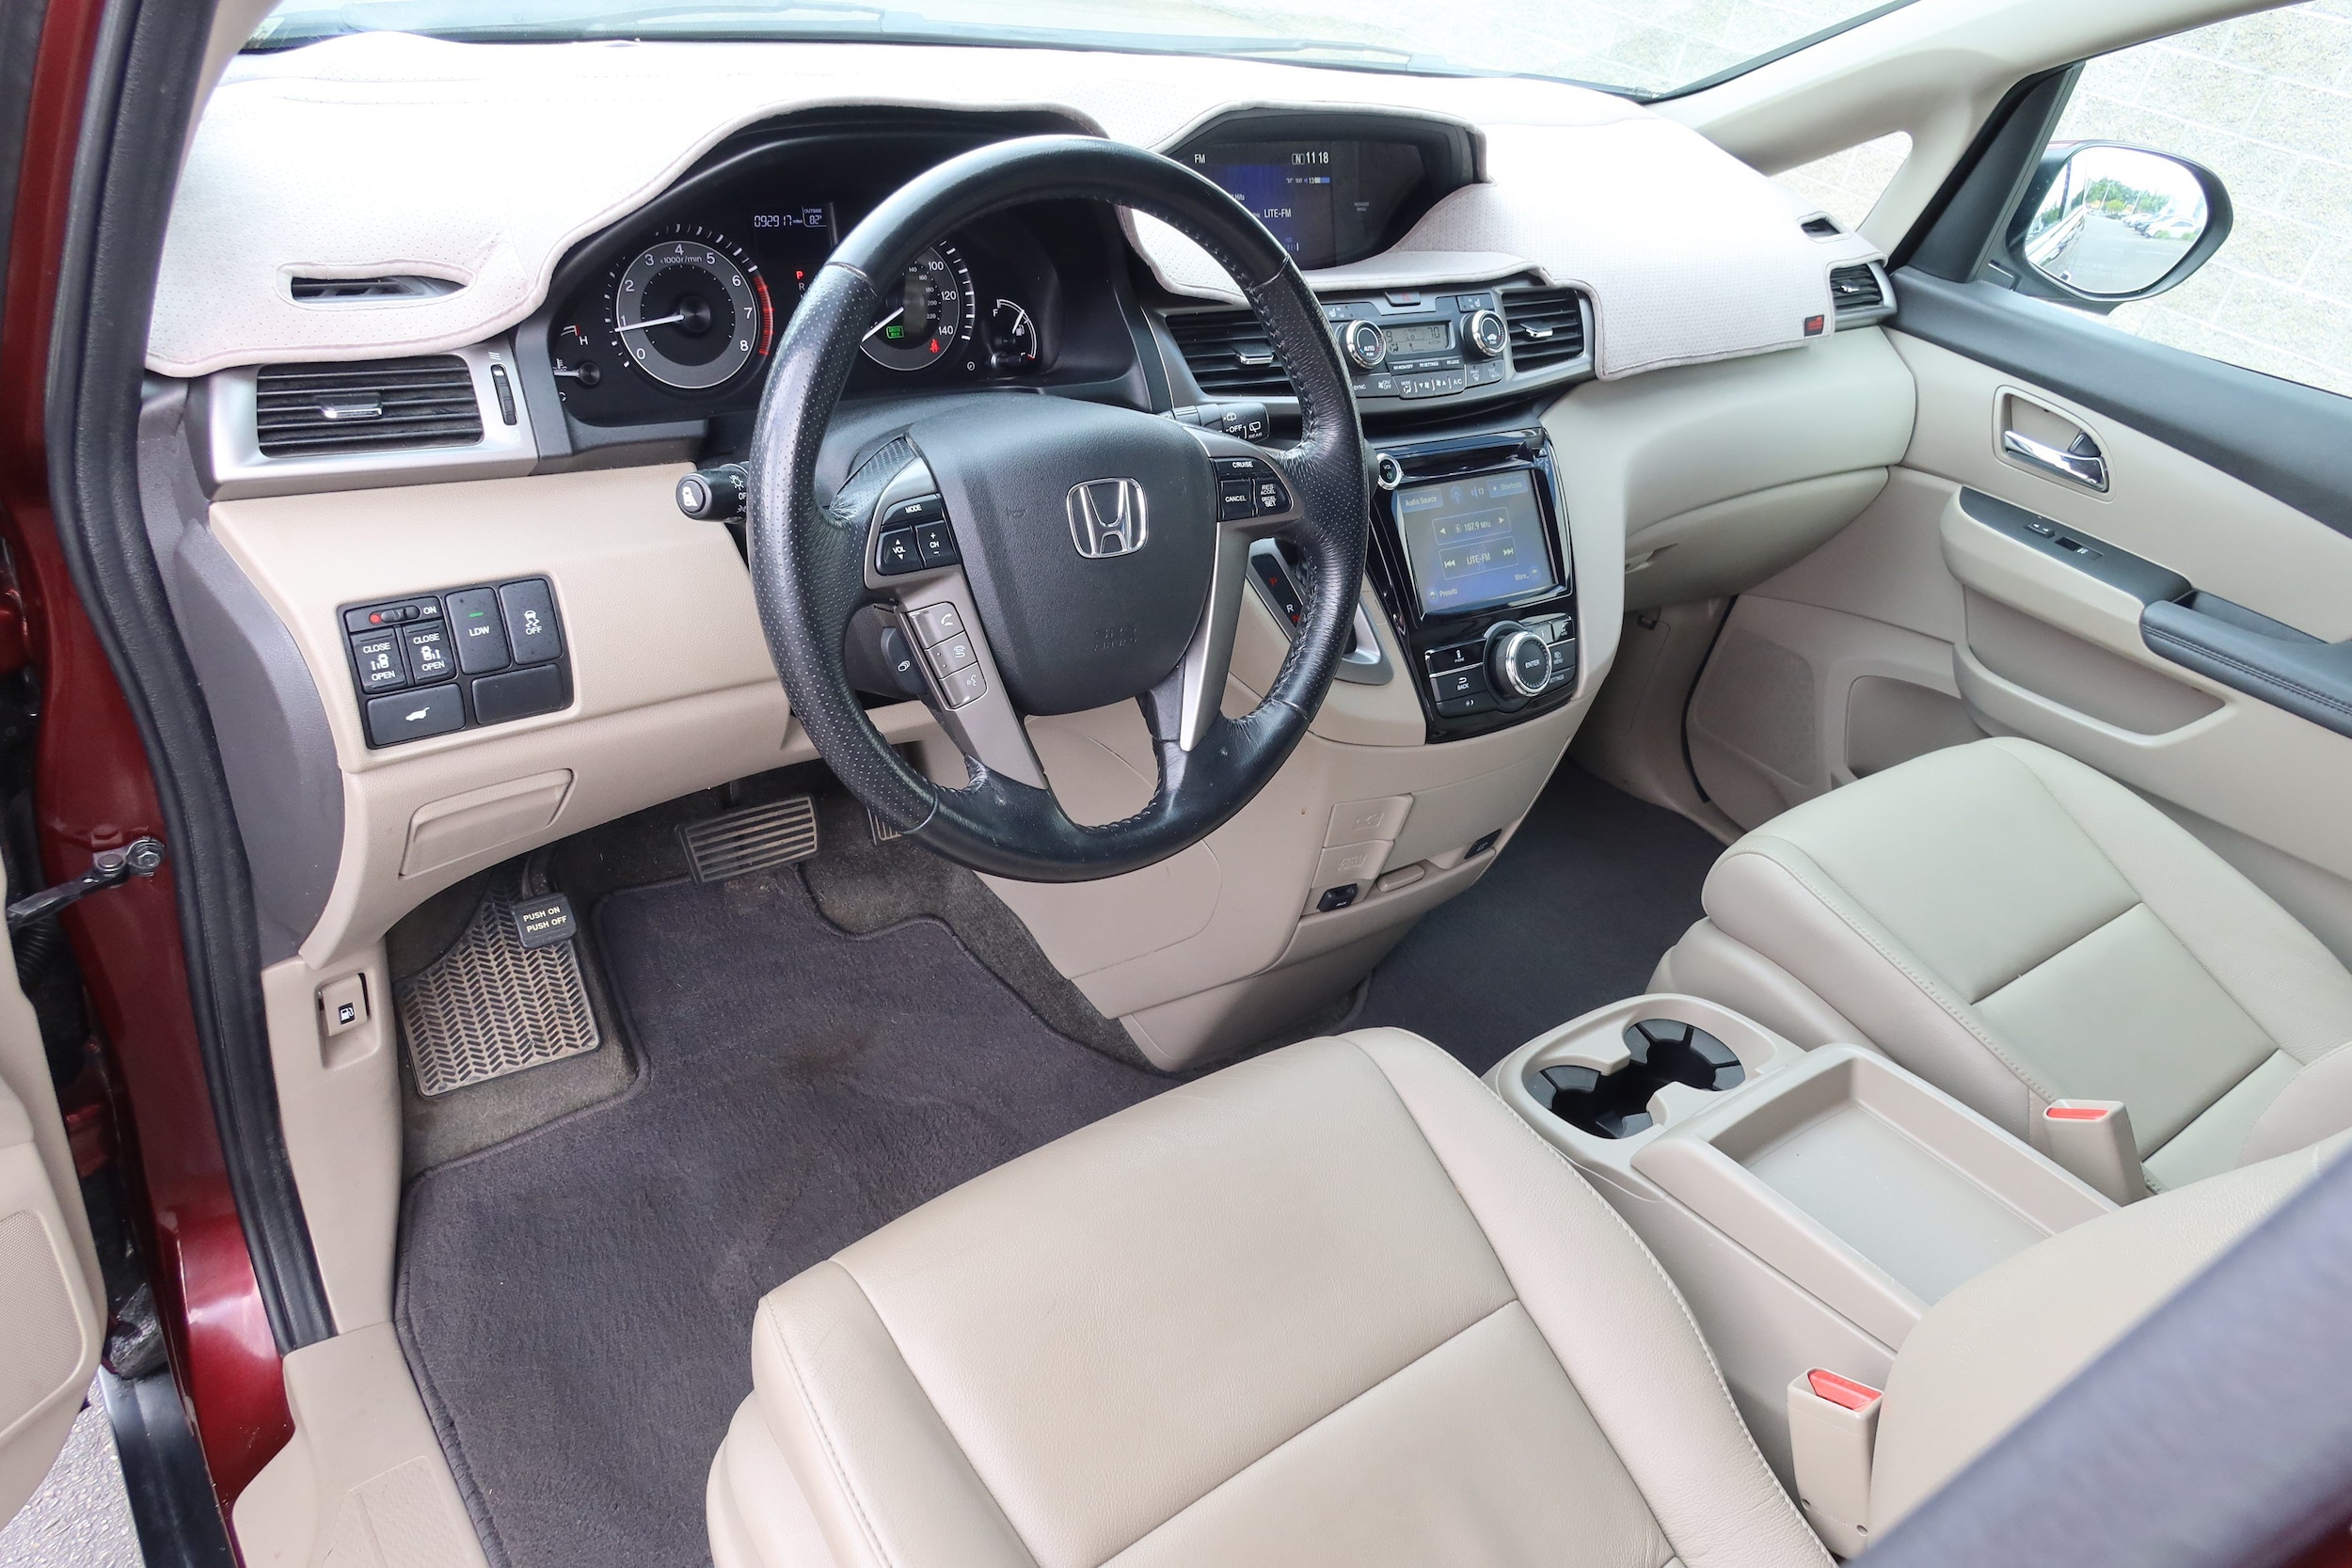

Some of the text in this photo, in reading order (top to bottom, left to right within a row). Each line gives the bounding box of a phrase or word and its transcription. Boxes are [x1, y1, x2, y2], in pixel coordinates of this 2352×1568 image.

[1194, 153, 1206, 164] FM
[1263, 208, 1292, 218] LITE-FM
[754, 214, 792, 228] 092917
[675, 244, 684, 255] 4
[644, 255, 655, 266] 3
[706, 253, 716, 264] 5
[928, 261, 945, 271] 100
[796, 270, 803, 280] P
[625, 280, 635, 292] 2
[732, 275, 741, 287] 6
[799, 282, 805, 291] R
[941, 291, 957, 301] 120
[744, 308, 753, 319] 7
[993, 309, 999, 318] F
[621, 315, 628, 326] 1
[938, 325, 954, 335] 140
[1427, 326, 1440, 339] 70
[580, 335, 588, 345] H
[739, 341, 749, 352] 8
[636, 348, 646, 360] 0
[1229, 424, 1242, 433] OFF
[1500, 481, 1522, 491] Shortcuts
[739, 492, 747, 500] OF
[1406, 496, 1438, 507] Audio Source
[905, 504, 922, 514] MODE
[1464, 520, 1480, 532] 107.9
[893, 546, 906, 554] VOL
[1466, 552, 1491, 565] LITE-FM
[1270, 577, 1278, 586] P
[1439, 587, 1458, 597] Presets
[423, 606, 437, 615] ON
[1286, 604, 1295, 613] R
[469, 626, 490, 637] LDW
[525, 626, 542, 636] OFF
[413, 633, 440, 644] CLOSE
[363, 642, 391, 654] CLOSE
[422, 660, 445, 672] OPEN
[1525, 658, 1540, 669] ENTER
[372, 671, 396, 681] OPEN
[1457, 683, 1470, 691] BACK
[523, 906, 561, 923] PUSH ON
[526, 915, 567, 933] PUSH OFF
